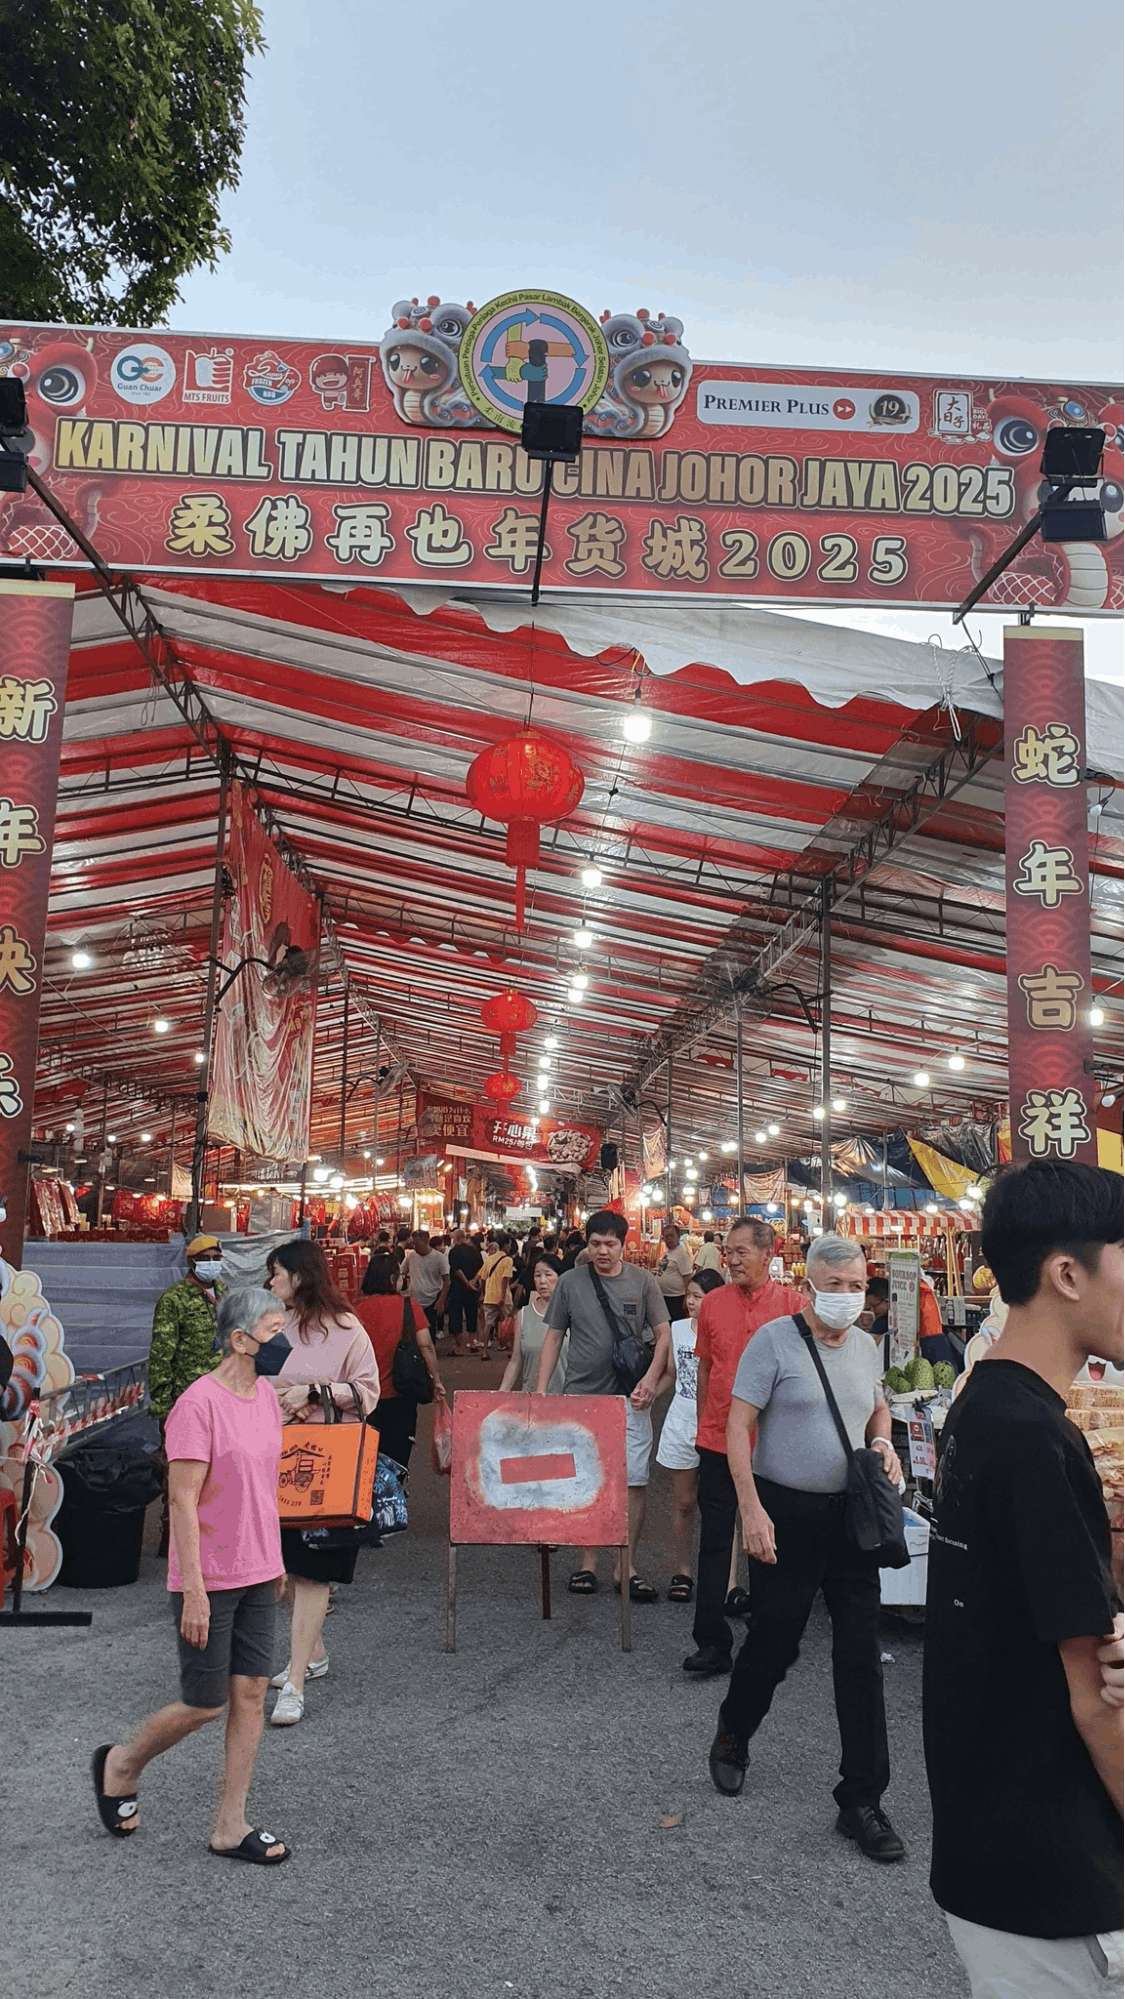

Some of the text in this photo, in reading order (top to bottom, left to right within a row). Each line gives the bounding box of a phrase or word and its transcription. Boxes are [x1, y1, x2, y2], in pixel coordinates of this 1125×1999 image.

[494, 294, 518, 309] Kechil
[518, 293, 542, 302] Pasar
[541, 294, 572, 310] Lambak
[571, 306, 597, 335] Bergerak
[593, 333, 606, 356] Johor
[463, 357, 479, 398] Persatuan
[595, 356, 606, 384] Selatan
[117, 382, 163, 392] Guan Chuar
[586, 384, 601, 404] Johor
[184, 392, 230, 403] MTS FRUITS
[703, 394, 830, 416] PREMIER PLUS
[880, 399, 900, 417] 19
[56, 419, 1013, 516] KARNIVAL TAHUN BARU CINA JOHOR JAYA 2025
[1013, 725, 1089, 1157] 蛇年吉祥
[891, 1268, 917, 1282] SOURSOP
[891, 1280, 907, 1291] JUICE
[953, 1598, 965, 1608] On
